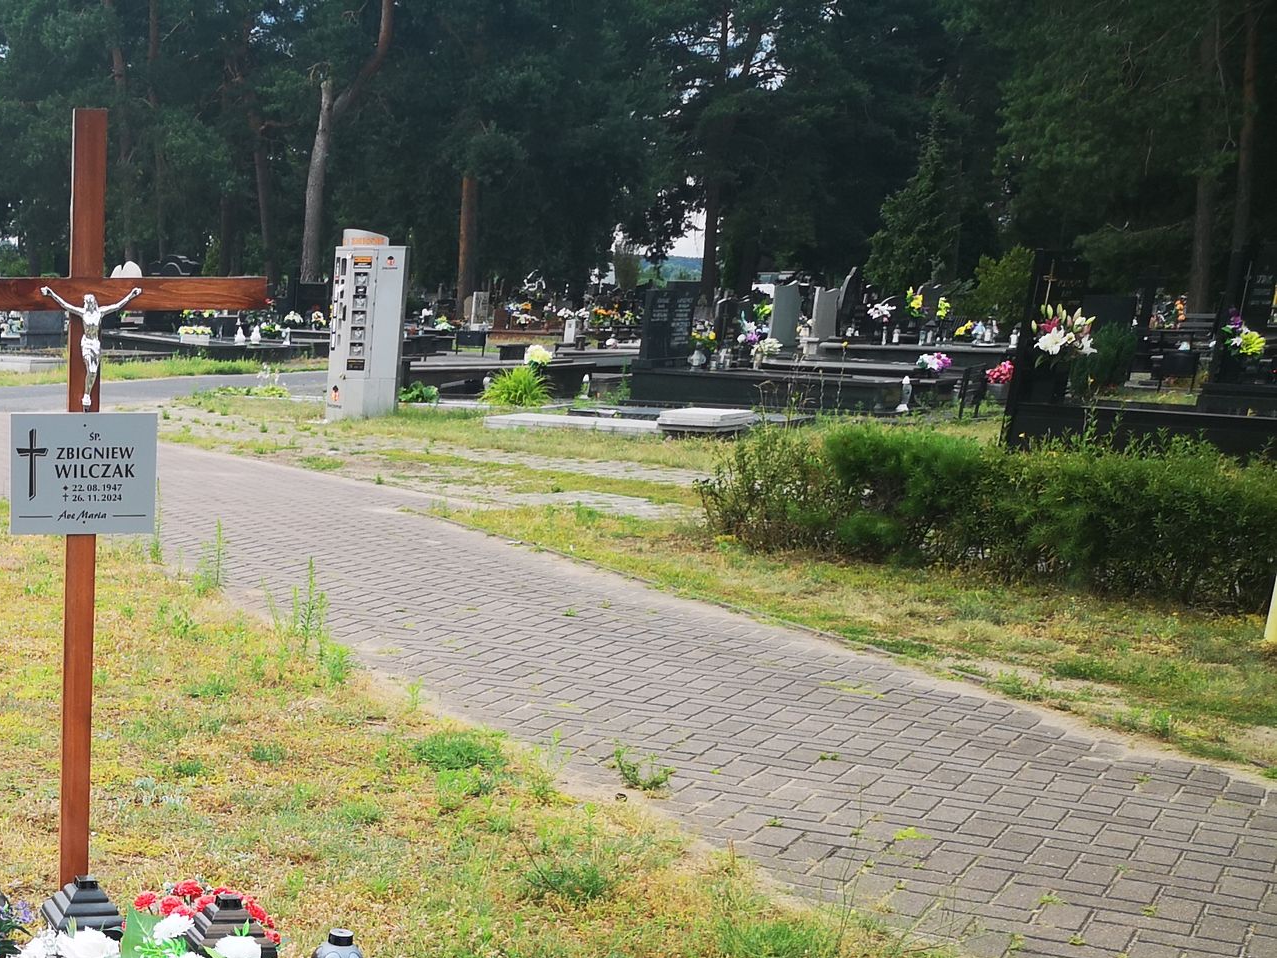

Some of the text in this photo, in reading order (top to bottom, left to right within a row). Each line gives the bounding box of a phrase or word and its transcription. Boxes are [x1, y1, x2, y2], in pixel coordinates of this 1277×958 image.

[56, 447, 134, 460] ZBIGNIEW
[54, 463, 135, 479] WILCZAK
[57, 510, 107, 521] Ave Maria
